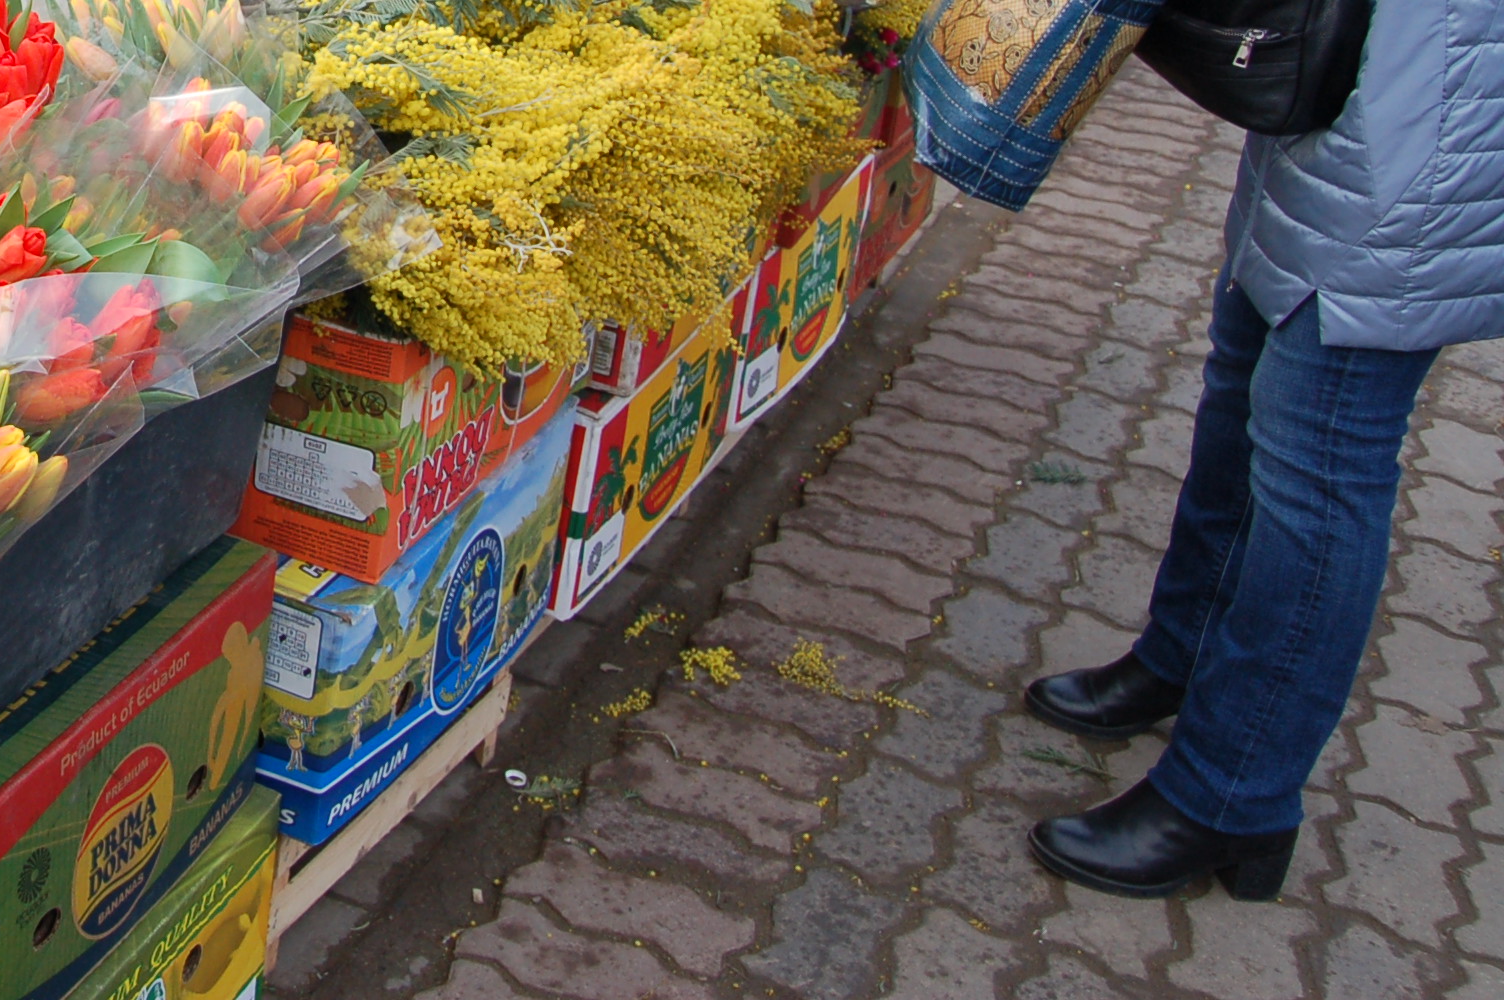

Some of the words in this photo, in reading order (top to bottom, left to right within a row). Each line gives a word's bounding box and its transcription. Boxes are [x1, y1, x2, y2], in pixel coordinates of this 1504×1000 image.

[60, 714, 118, 776] Product
[119, 701, 134, 721] of
[136, 651, 191, 706] Ecuador
[104, 756, 150, 804] PREMIUM
[189, 784, 244, 857] BANANAS
[327, 743, 409, 826] PREMIUM
[88, 817, 158, 900] DONNA
[90, 791, 157, 872] PRIMA
[97, 872, 145, 926] BANANAS
[150, 865, 234, 972] QUALITY
